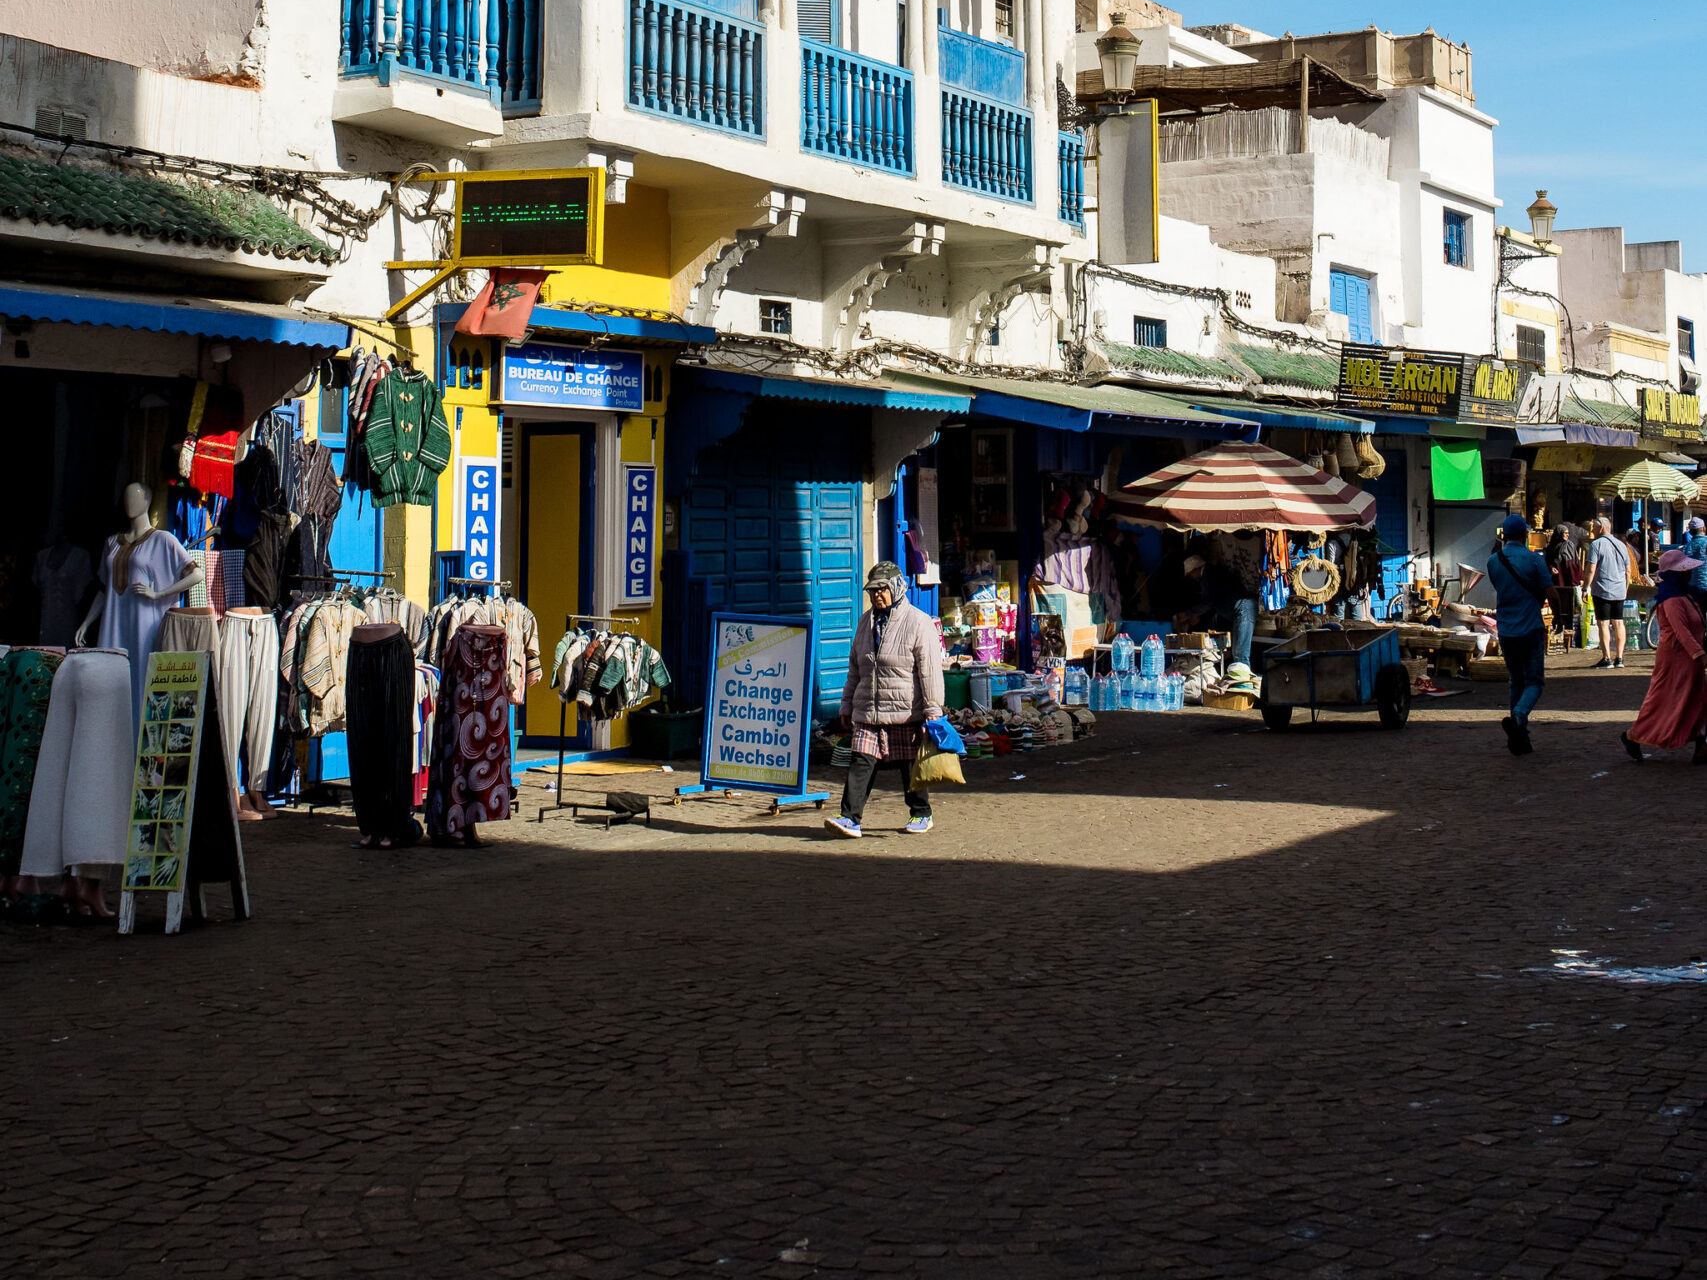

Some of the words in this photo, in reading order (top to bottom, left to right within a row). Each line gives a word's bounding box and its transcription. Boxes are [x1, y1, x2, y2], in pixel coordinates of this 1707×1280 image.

[584, 355, 623, 373] صرف
[508, 366, 562, 382] BUREAU
[565, 372, 583, 383] DE
[585, 373, 639, 387] CHANGE
[1345, 358, 1384, 389] MOL
[1391, 362, 1457, 394] ARGAN
[1474, 363, 1491, 398] MOL
[520, 381, 558, 395] Currency
[562, 384, 602, 397] Exchange
[606, 388, 628, 398] Point
[1395, 390, 1447, 404] COSMETIQUE
[469, 470, 490, 580] CHANG
[630, 475, 648, 595] CHANGE
[171, 674, 198, 683] فاطمة
[734, 659, 787, 681] الصرف
[724, 680, 794, 705] Change
[718, 700, 797, 727] Exchange
[722, 724, 791, 747] Cambio
[719, 745, 791, 768] Wechsel
